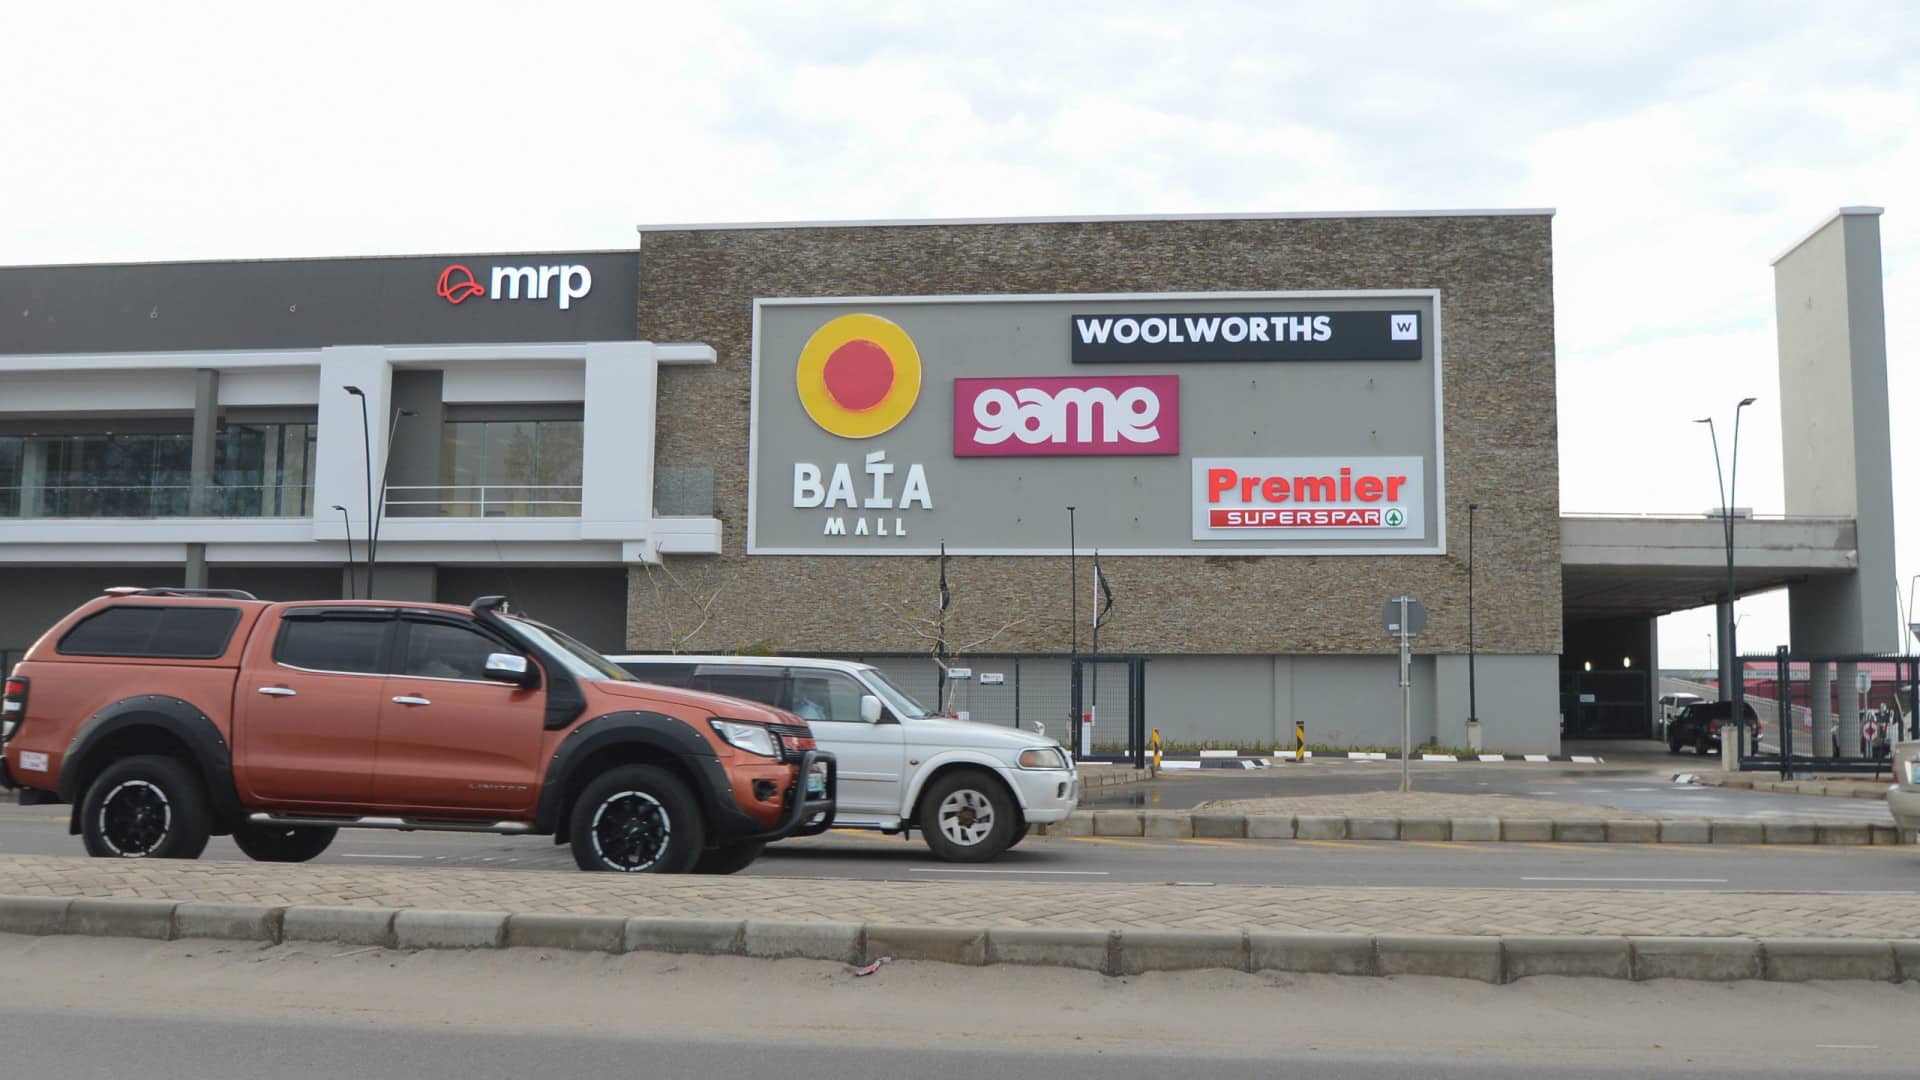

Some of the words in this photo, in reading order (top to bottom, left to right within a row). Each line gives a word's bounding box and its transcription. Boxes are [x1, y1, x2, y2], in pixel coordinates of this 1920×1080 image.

[490, 264, 592, 310] mrp
[1077, 315, 1332, 344] WOOLWORTHS
[1397, 322, 1412, 333] W
[973, 386, 1160, 445] game
[793, 450, 933, 509] BAÍA
[1208, 467, 1407, 503] Premier
[824, 517, 906, 536] MALL
[1227, 511, 1379, 525] SUPERSPAR
